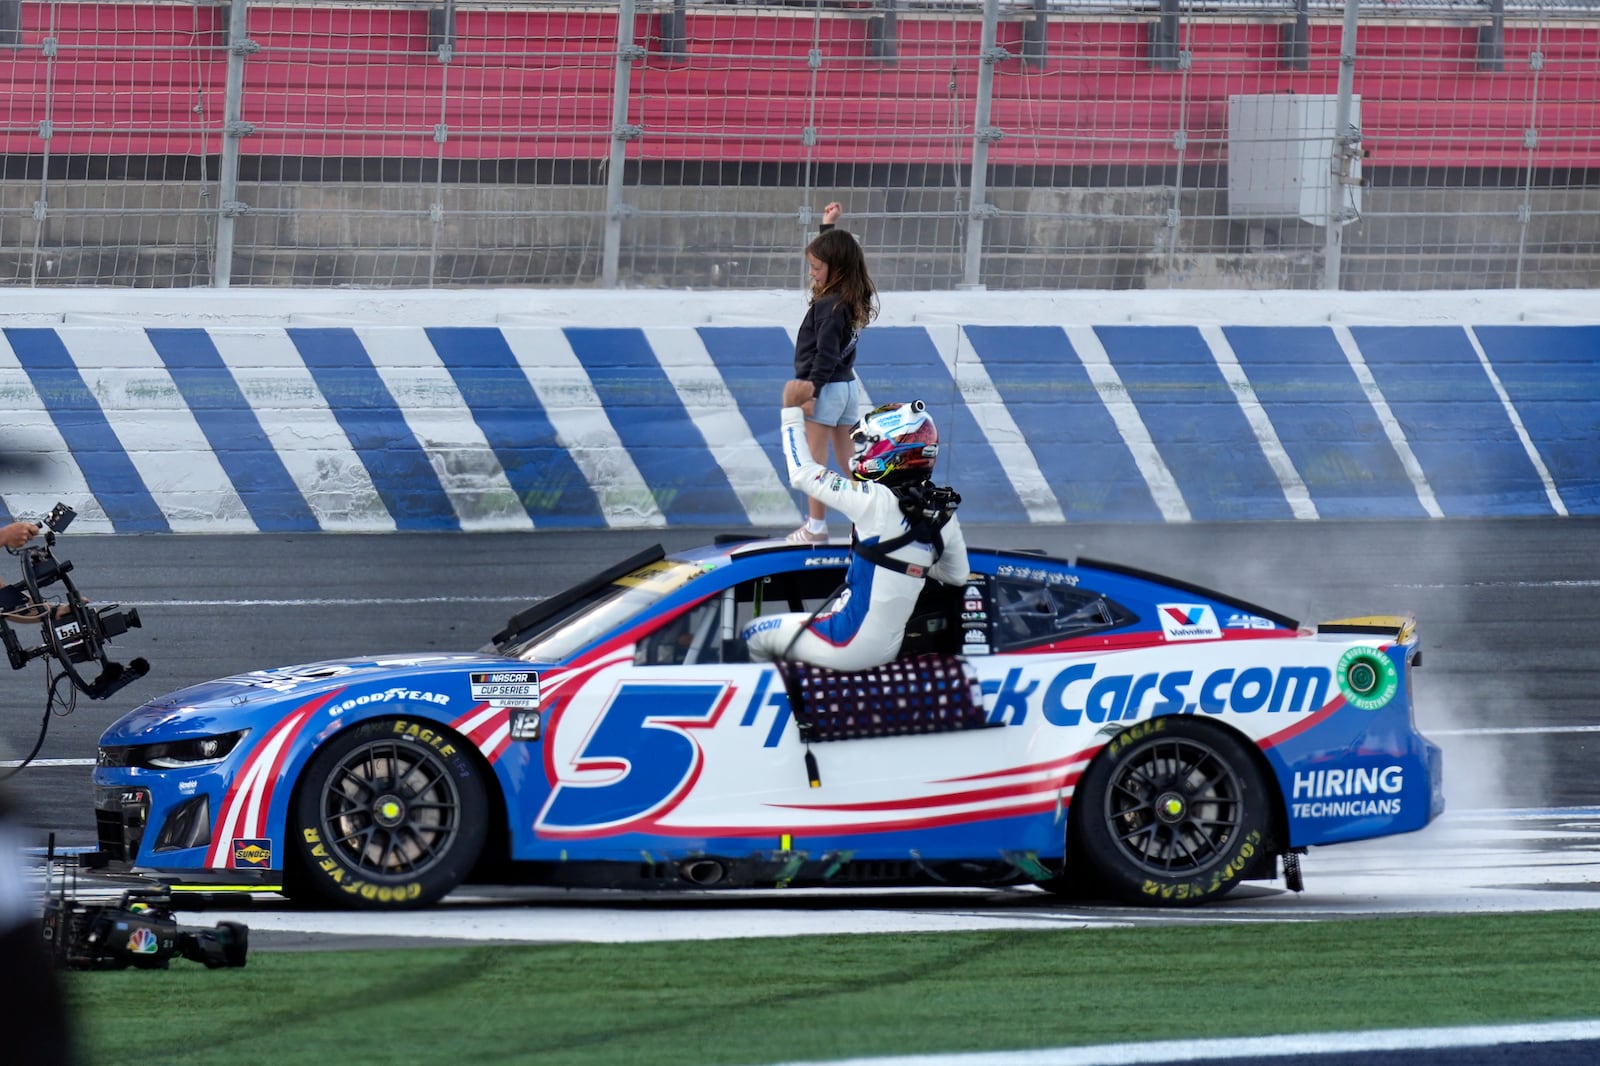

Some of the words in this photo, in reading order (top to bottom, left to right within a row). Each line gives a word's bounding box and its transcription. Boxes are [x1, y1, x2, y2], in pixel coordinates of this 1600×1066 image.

[60, 624, 78, 638] bsi
[1170, 628, 1214, 637] Valvoline
[481, 686, 498, 695] CUP
[499, 686, 529, 695] SERIES
[491, 674, 529, 682] NASCAR
[328, 687, 450, 717] GOODYEAR
[392, 720, 457, 758] EAGLE
[1109, 718, 1168, 756] EAGLE
[532, 679, 738, 832] 5
[1293, 765, 1404, 800] HIRING
[1292, 799, 1402, 819] TECHNICIANS
[236, 849, 270, 859] SUNOCO
[303, 828, 422, 901] GOODYEAR
